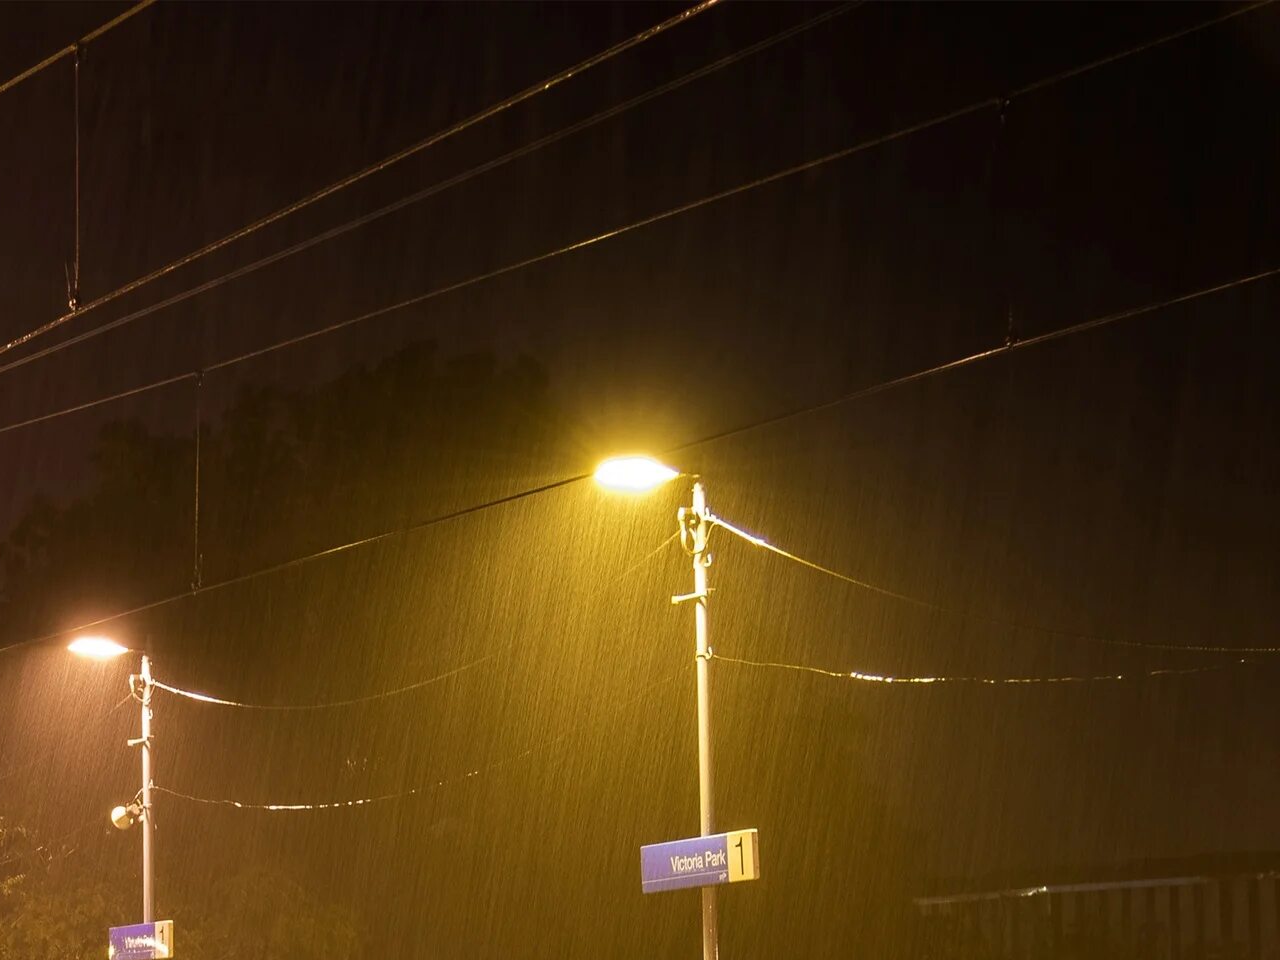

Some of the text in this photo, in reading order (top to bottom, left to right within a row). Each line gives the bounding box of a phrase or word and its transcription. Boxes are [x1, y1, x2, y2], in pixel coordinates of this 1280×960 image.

[670, 849, 726, 872] Victoria Park
[735, 836, 745, 876] 1
